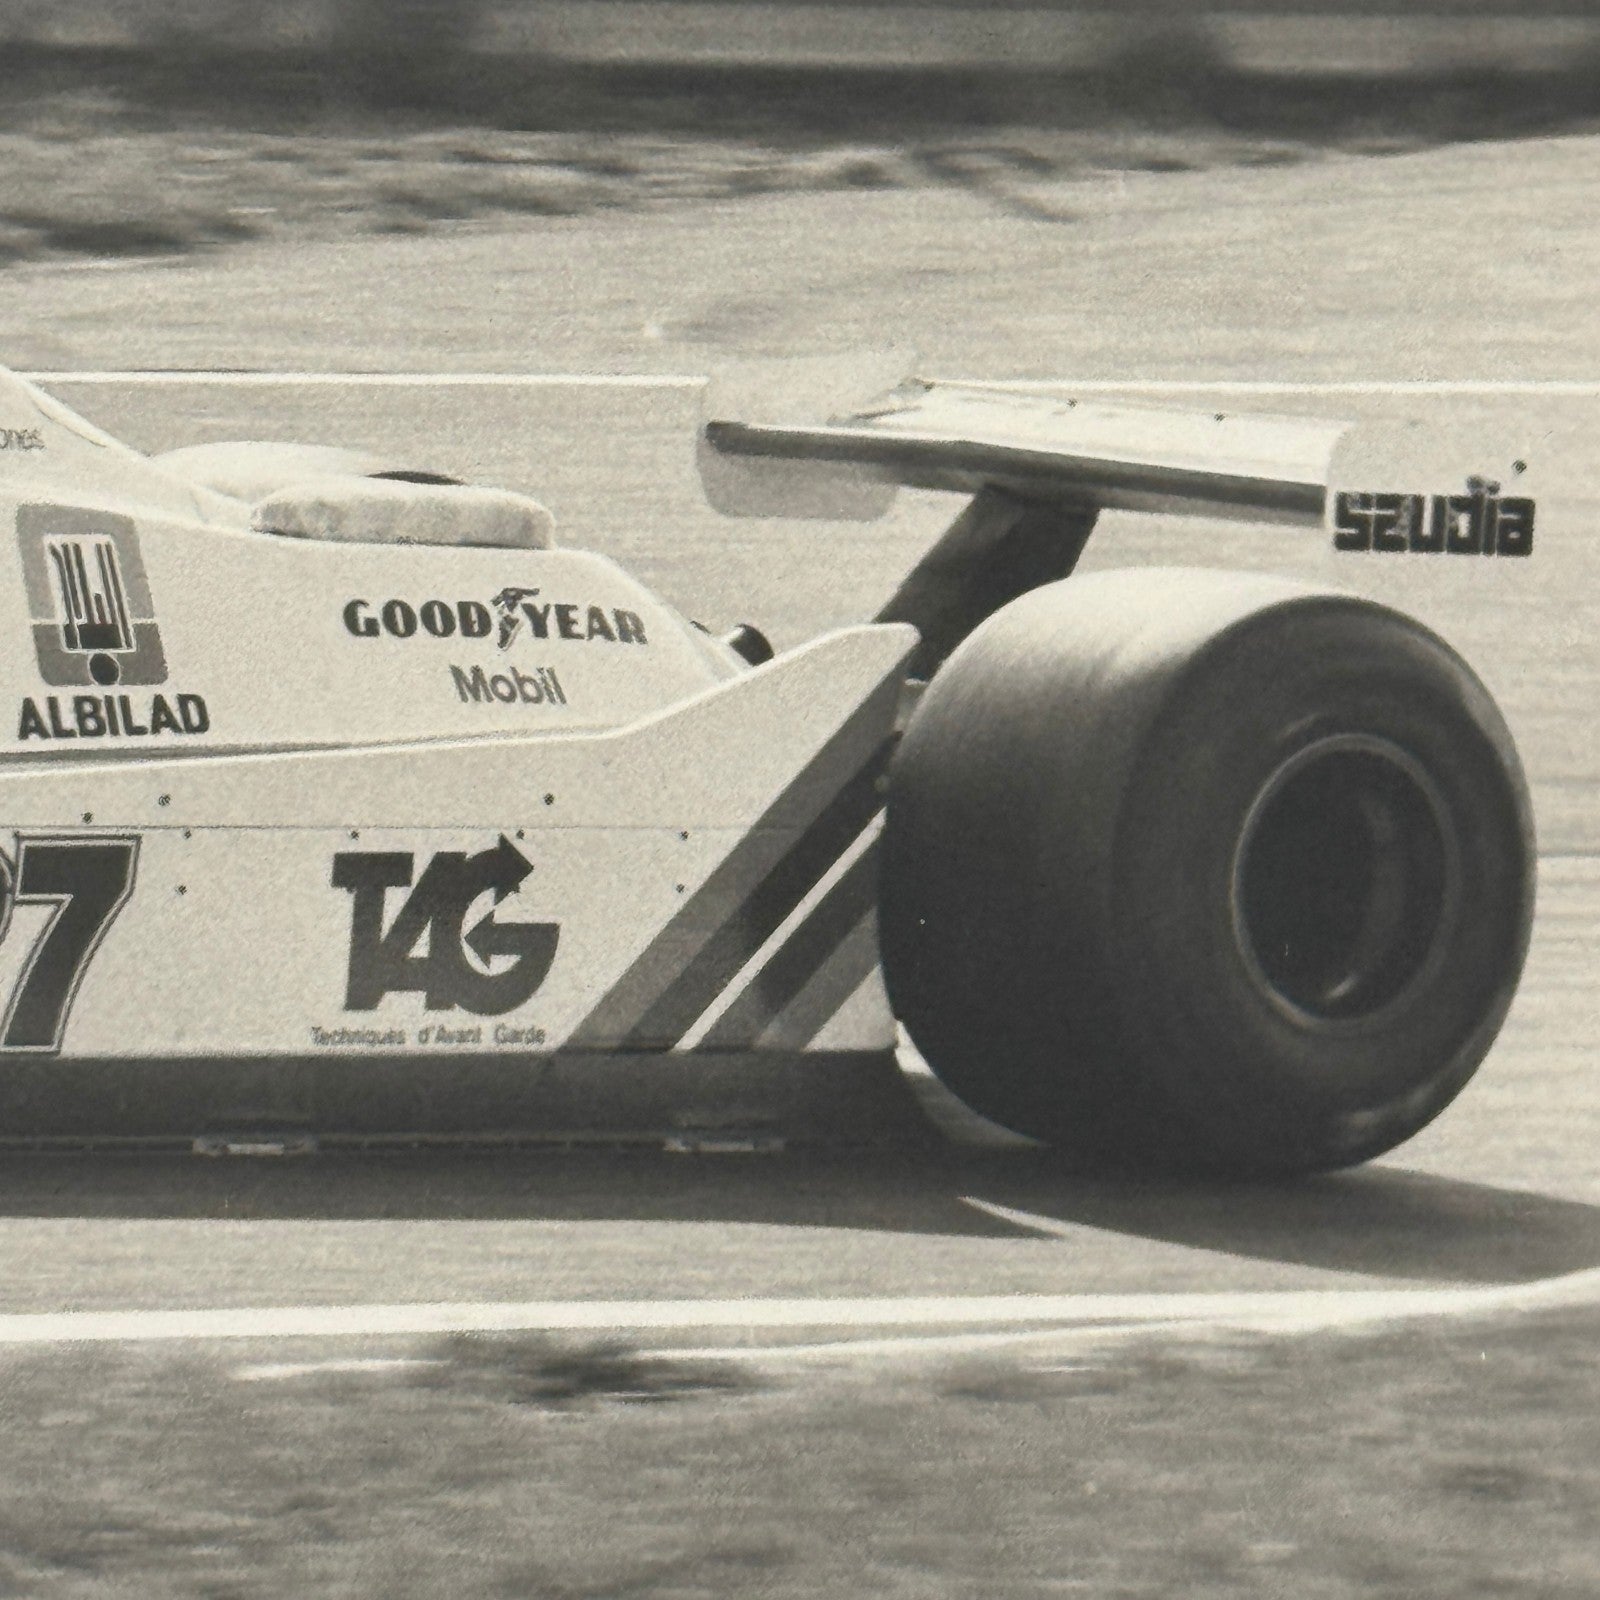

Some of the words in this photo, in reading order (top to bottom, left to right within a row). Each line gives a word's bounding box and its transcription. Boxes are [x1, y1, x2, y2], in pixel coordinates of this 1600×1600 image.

[342, 598, 649, 645] GOODYEAR
[449, 664, 567, 704] Mobil
[18, 693, 210, 740] ALBILAD
[0, 831, 142, 1055] 7
[331, 832, 561, 1016] TAG
